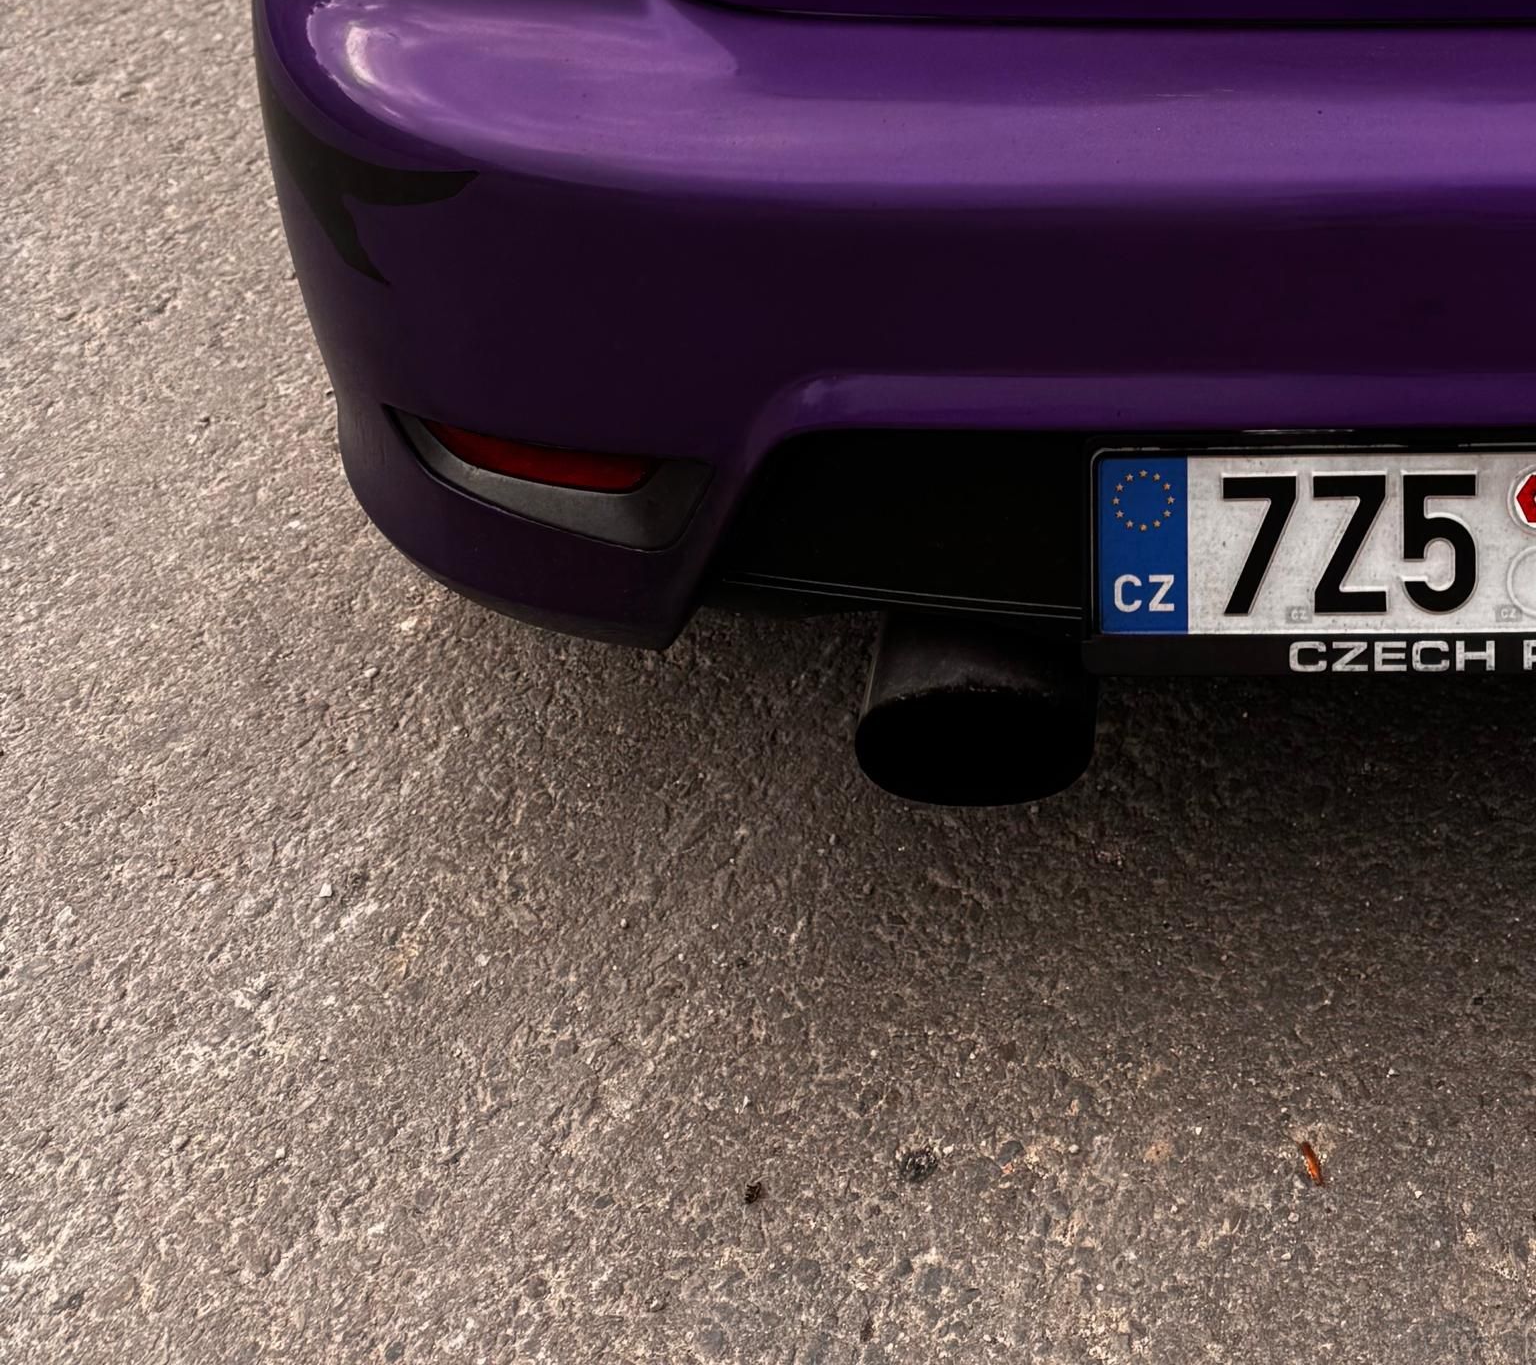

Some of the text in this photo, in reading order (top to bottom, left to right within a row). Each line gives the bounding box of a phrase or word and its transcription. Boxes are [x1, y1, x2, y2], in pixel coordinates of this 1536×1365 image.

[1220, 471, 1479, 615] 7Z5
[1113, 573, 1175, 612] CZ
[1289, 640, 1496, 672] CZECH
